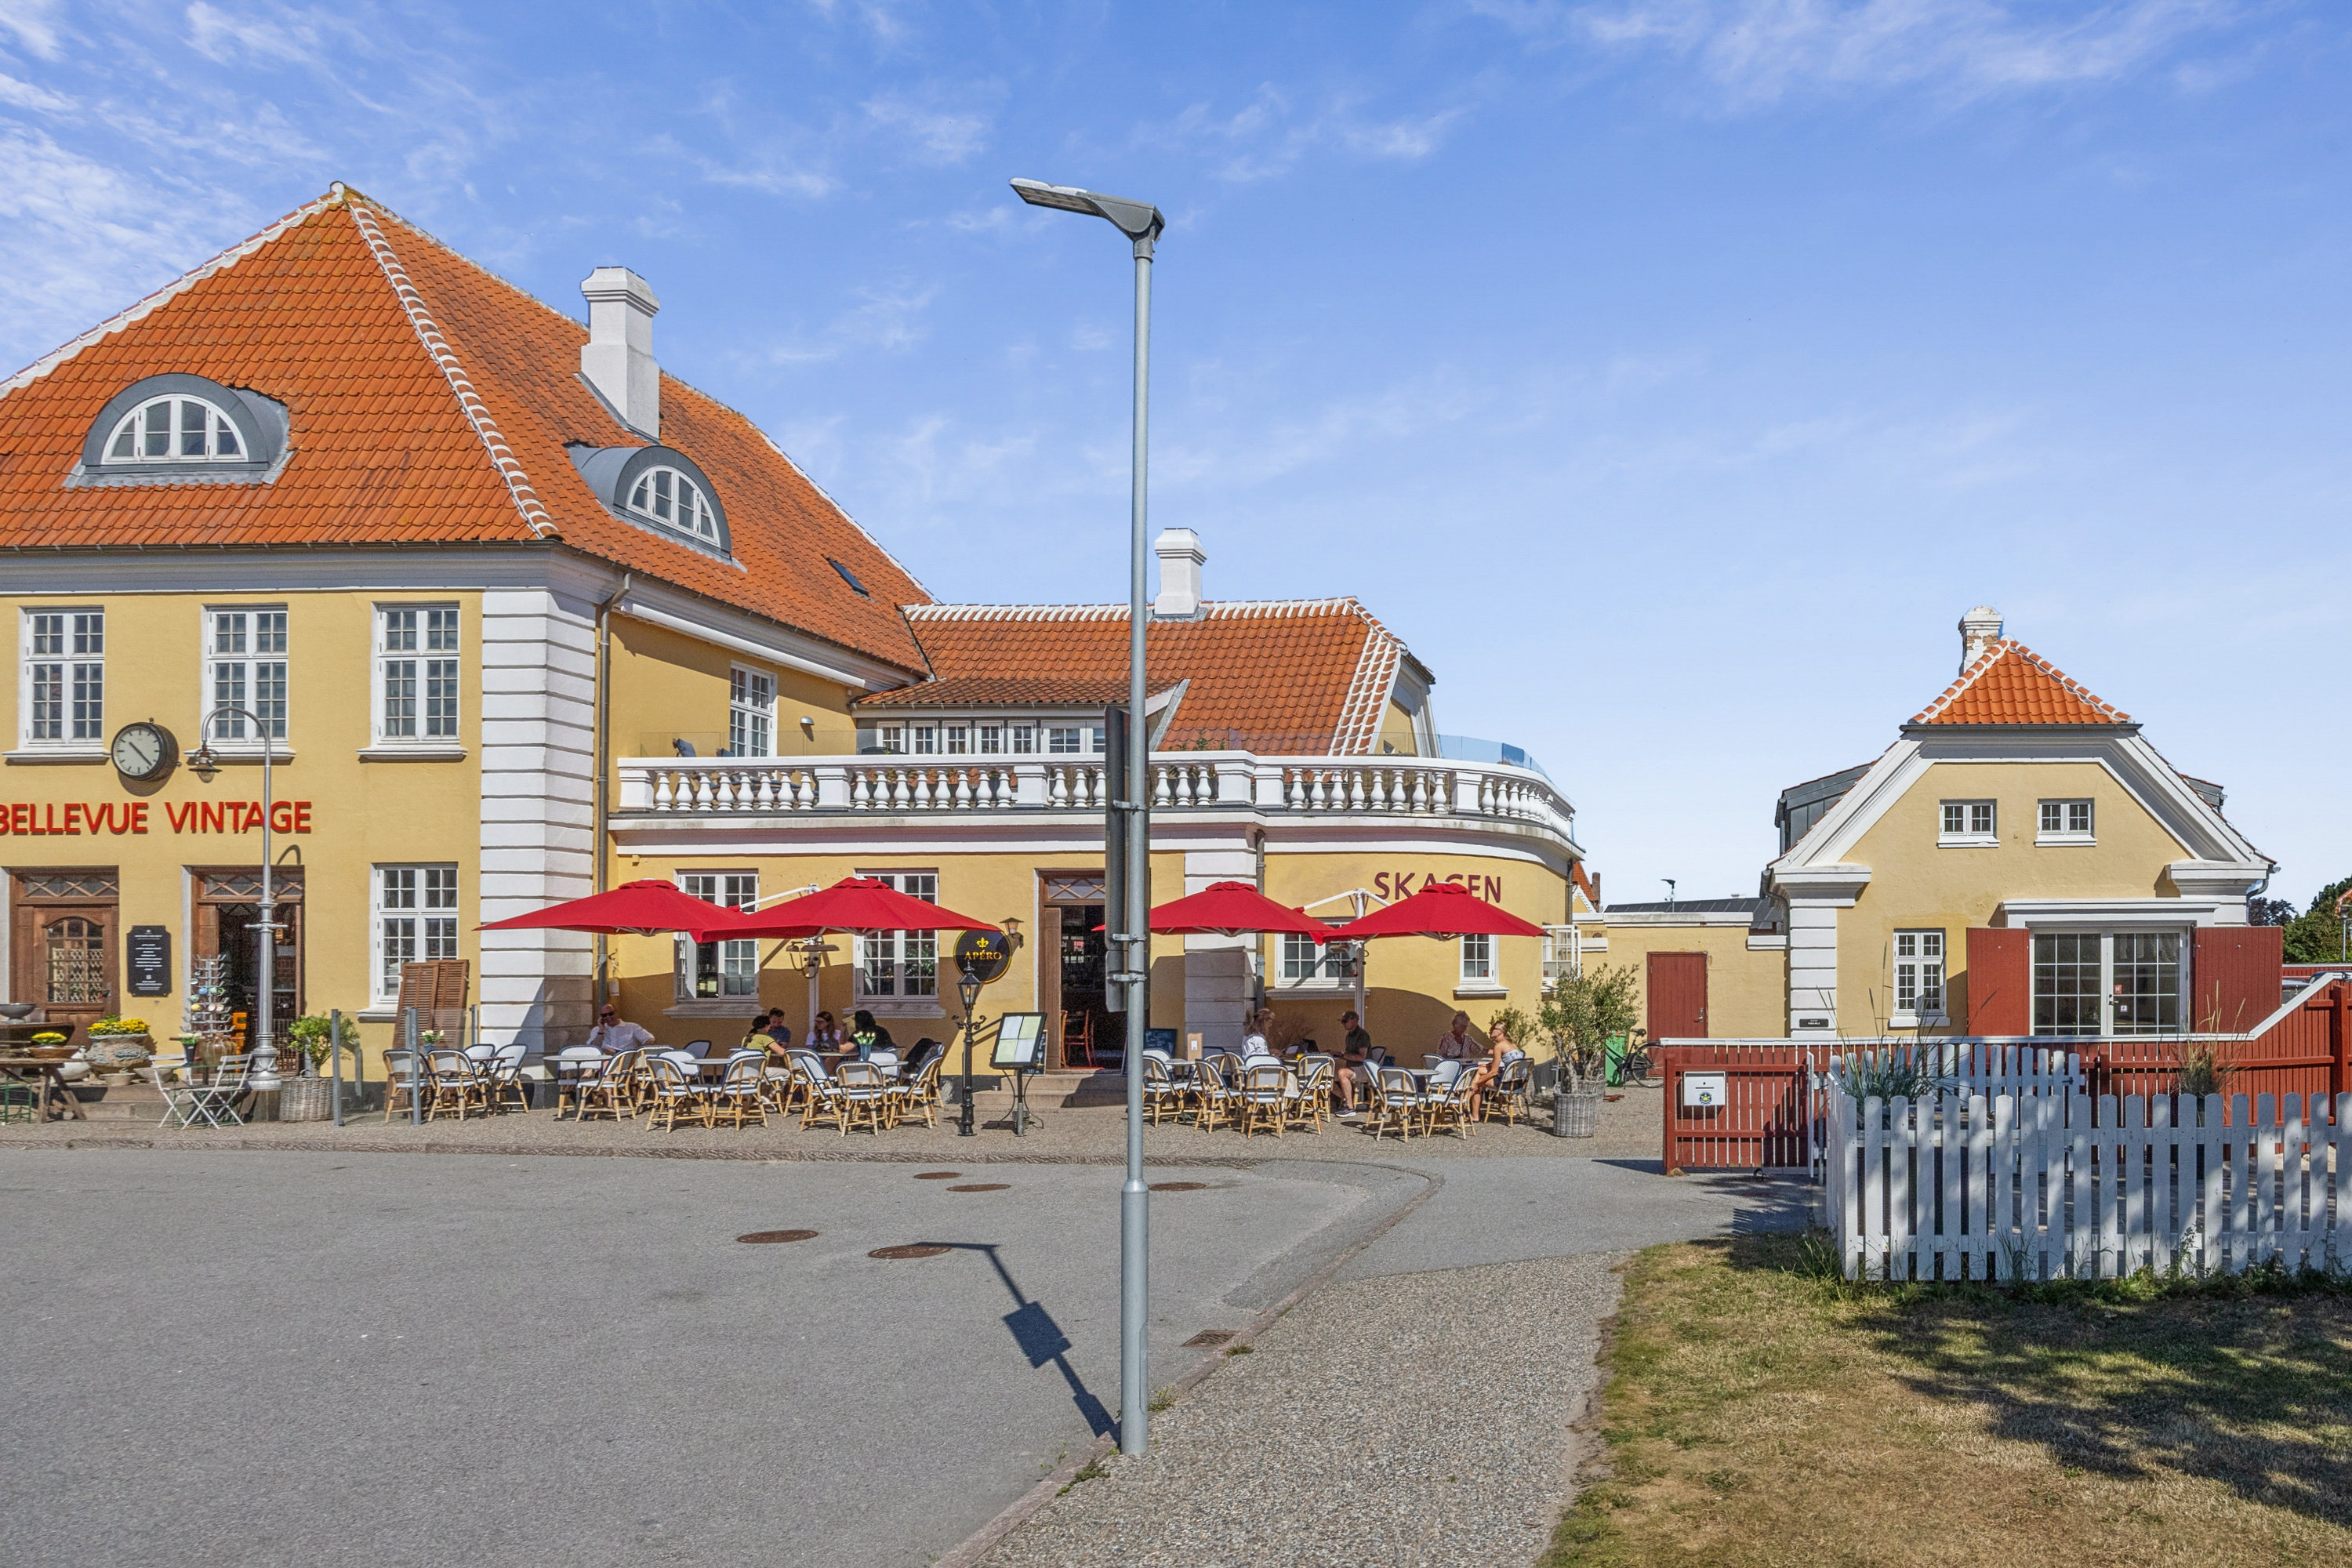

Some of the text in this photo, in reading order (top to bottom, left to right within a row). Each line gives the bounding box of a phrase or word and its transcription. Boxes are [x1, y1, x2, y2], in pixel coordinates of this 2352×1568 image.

[0, 800, 311, 835] BELLEVUE VINTAGE
[964, 949, 1002, 960] APÉRO
